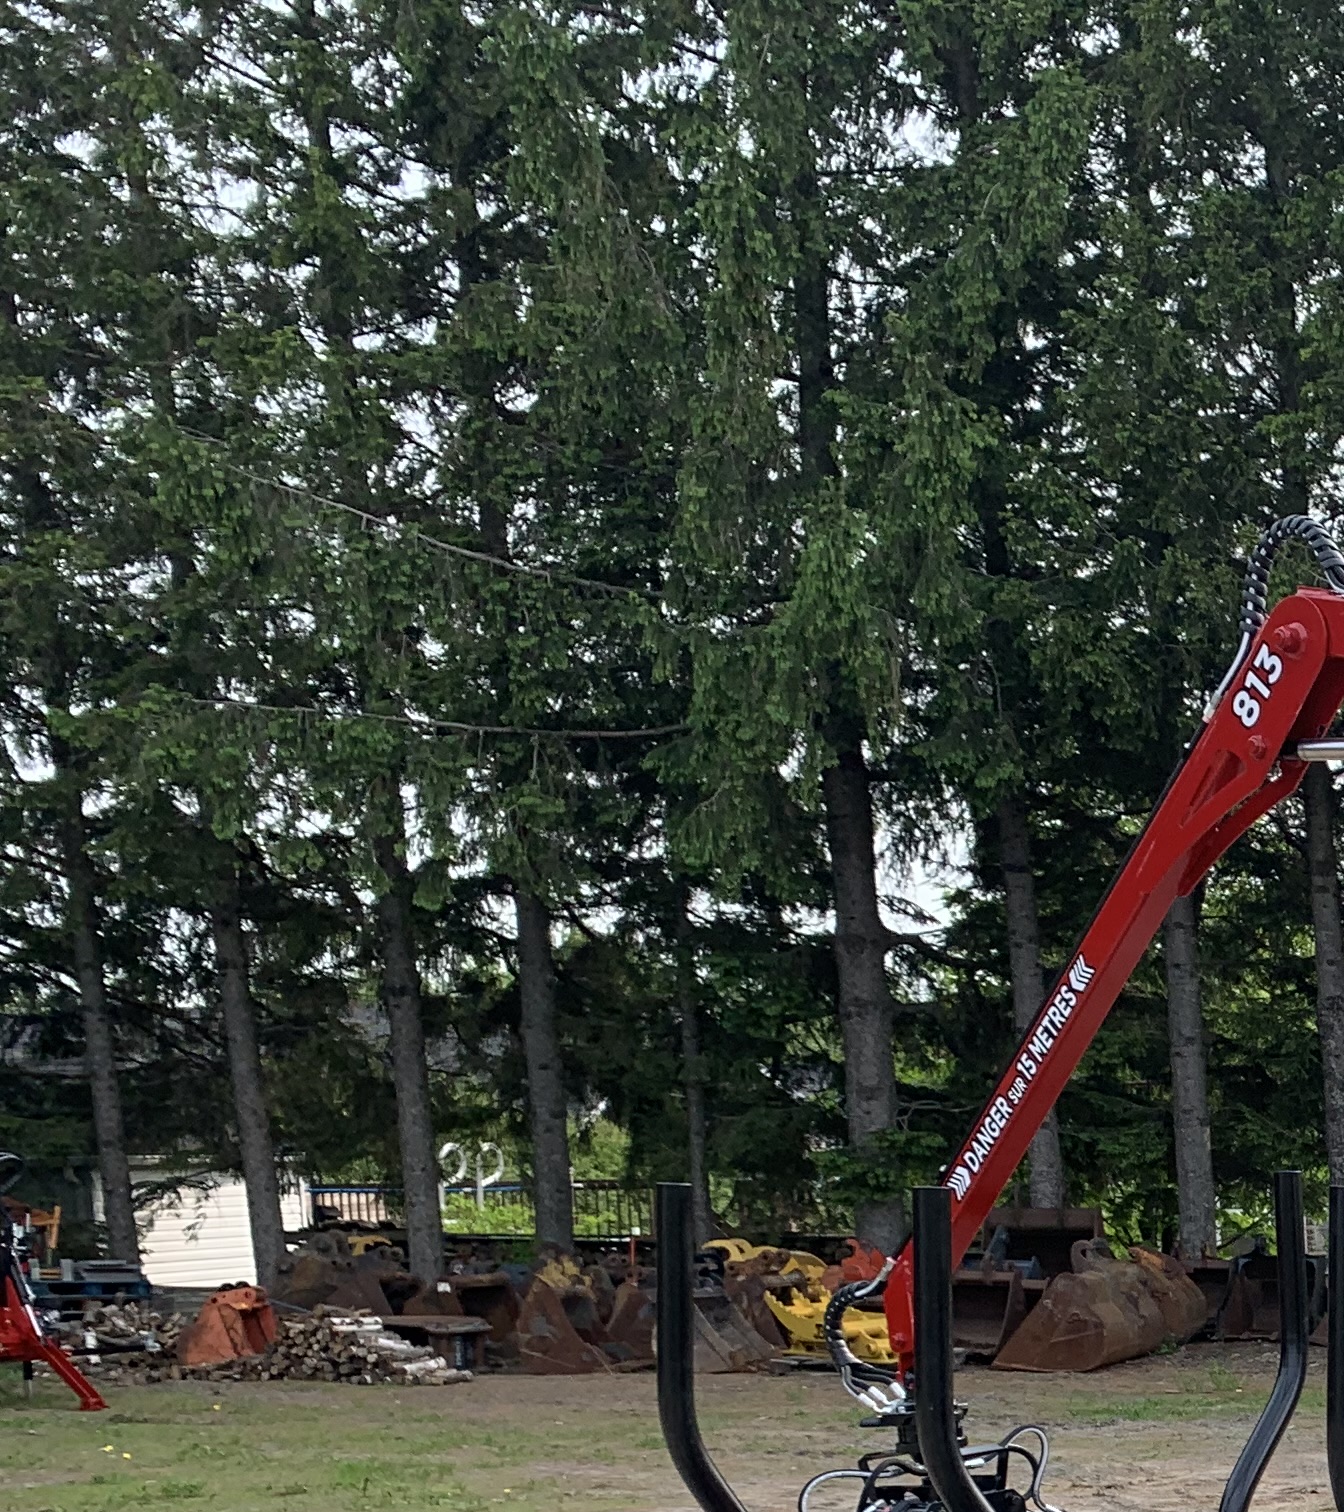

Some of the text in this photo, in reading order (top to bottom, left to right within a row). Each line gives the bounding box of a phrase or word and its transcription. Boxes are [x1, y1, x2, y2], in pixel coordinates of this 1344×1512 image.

[1232, 643, 1284, 728] 813
[963, 984, 1078, 1173] DANGER SUR 15 METRES
